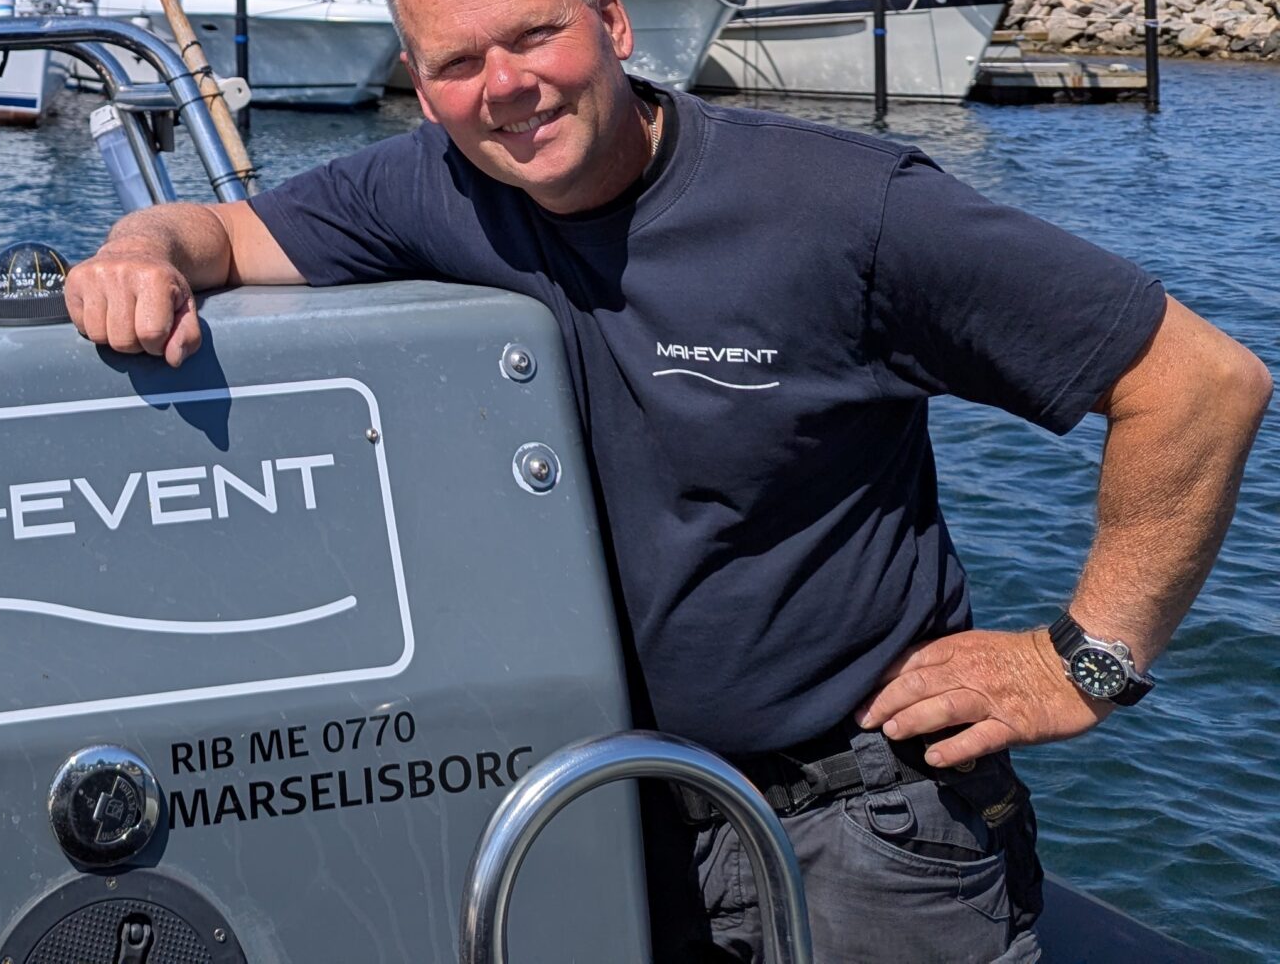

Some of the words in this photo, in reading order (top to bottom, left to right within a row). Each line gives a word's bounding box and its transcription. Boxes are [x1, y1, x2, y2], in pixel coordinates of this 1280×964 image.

[656, 342, 778, 364] MAI-EVENT
[171, 736, 235, 774] RIB
[249, 725, 309, 764] ME
[322, 711, 416, 753] 0770
